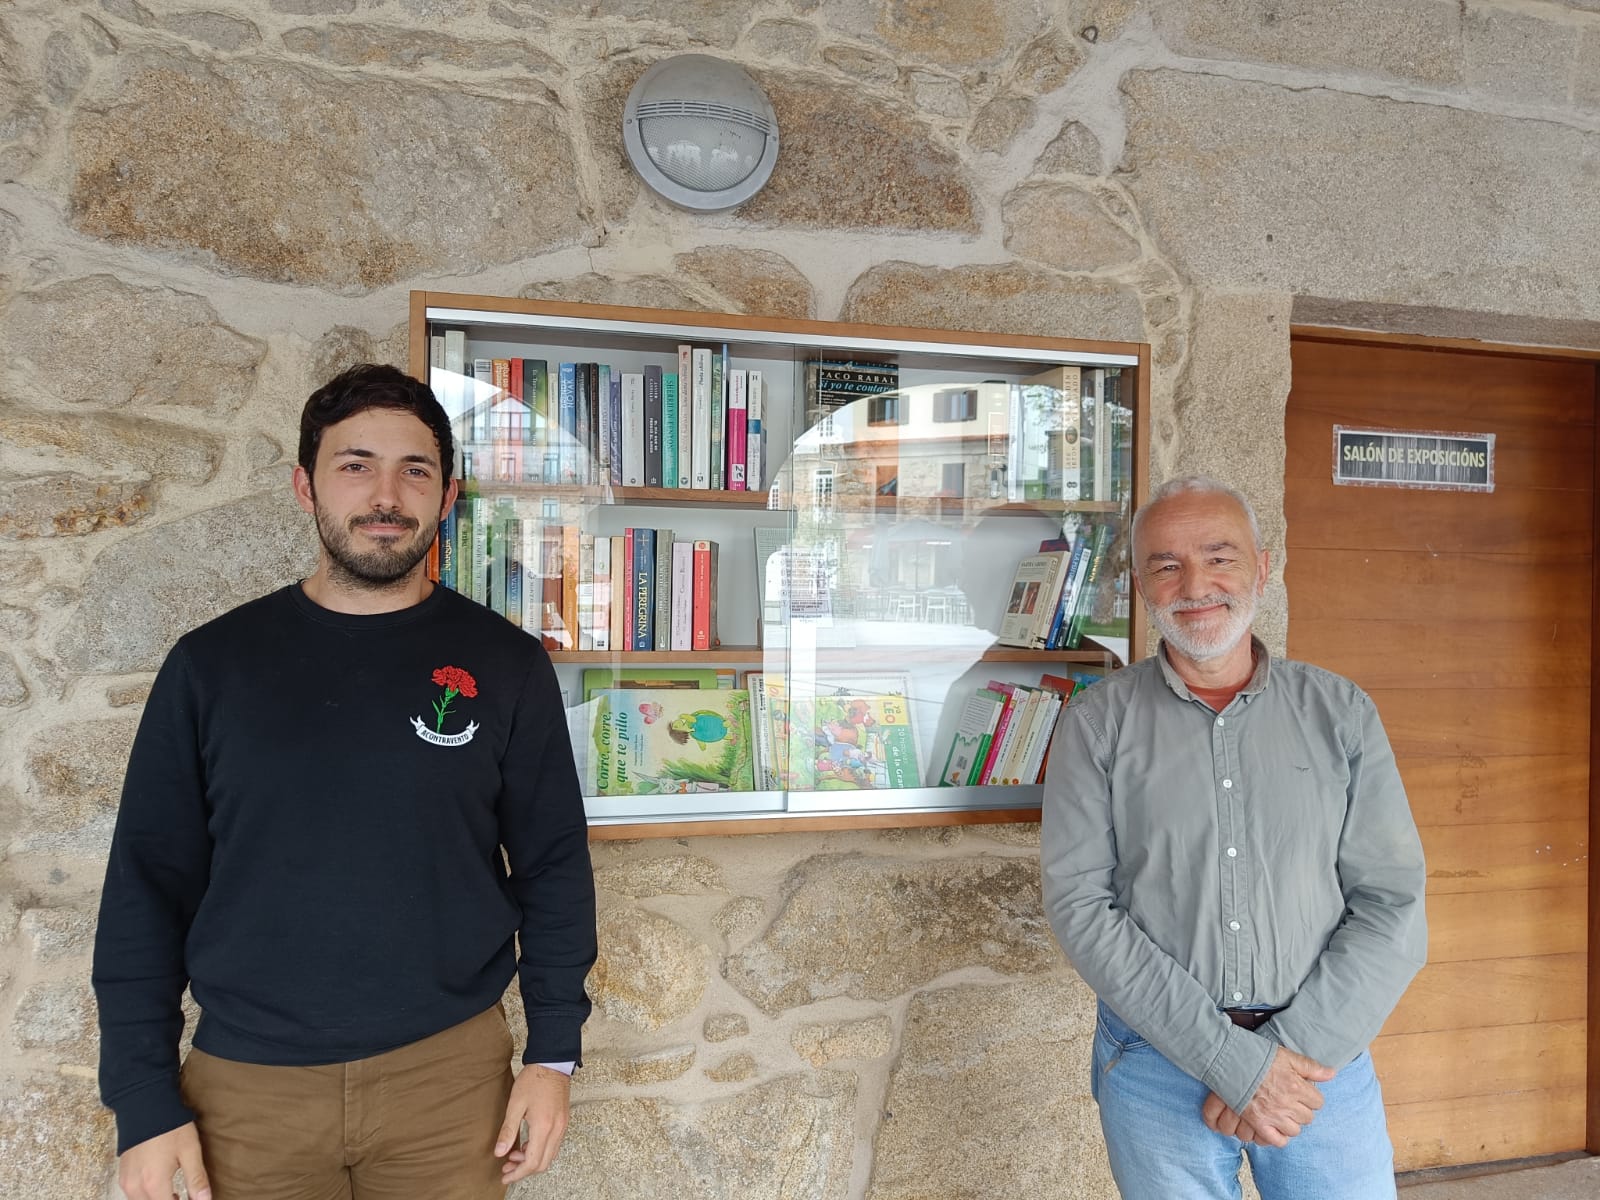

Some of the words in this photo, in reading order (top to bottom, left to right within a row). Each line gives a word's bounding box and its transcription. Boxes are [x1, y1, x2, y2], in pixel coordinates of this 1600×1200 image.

[820, 371, 851, 381] PACO
[857, 374, 895, 385] RABAL
[829, 382, 842, 391] yo
[844, 382, 854, 391] te
[567, 379, 575, 409] NOVAK
[1343, 442, 1384, 463] SALÓN
[1388, 448, 1404, 464] DE
[1407, 448, 1486, 468] EXPOSICIÓNS
[639, 572, 648, 585] LA
[638, 587, 648, 639] PEREGRINA
[882, 701, 896, 724] LEO
[420, 730, 470, 745] ACONTRAVENTO
[601, 711, 613, 746] corre,
[615, 711, 629, 741] pillo
[616, 743, 627, 756] te
[892, 746, 900, 757] de
[597, 750, 611, 790] Corre,
[616, 759, 628, 783] que
[894, 759, 900, 767] la
